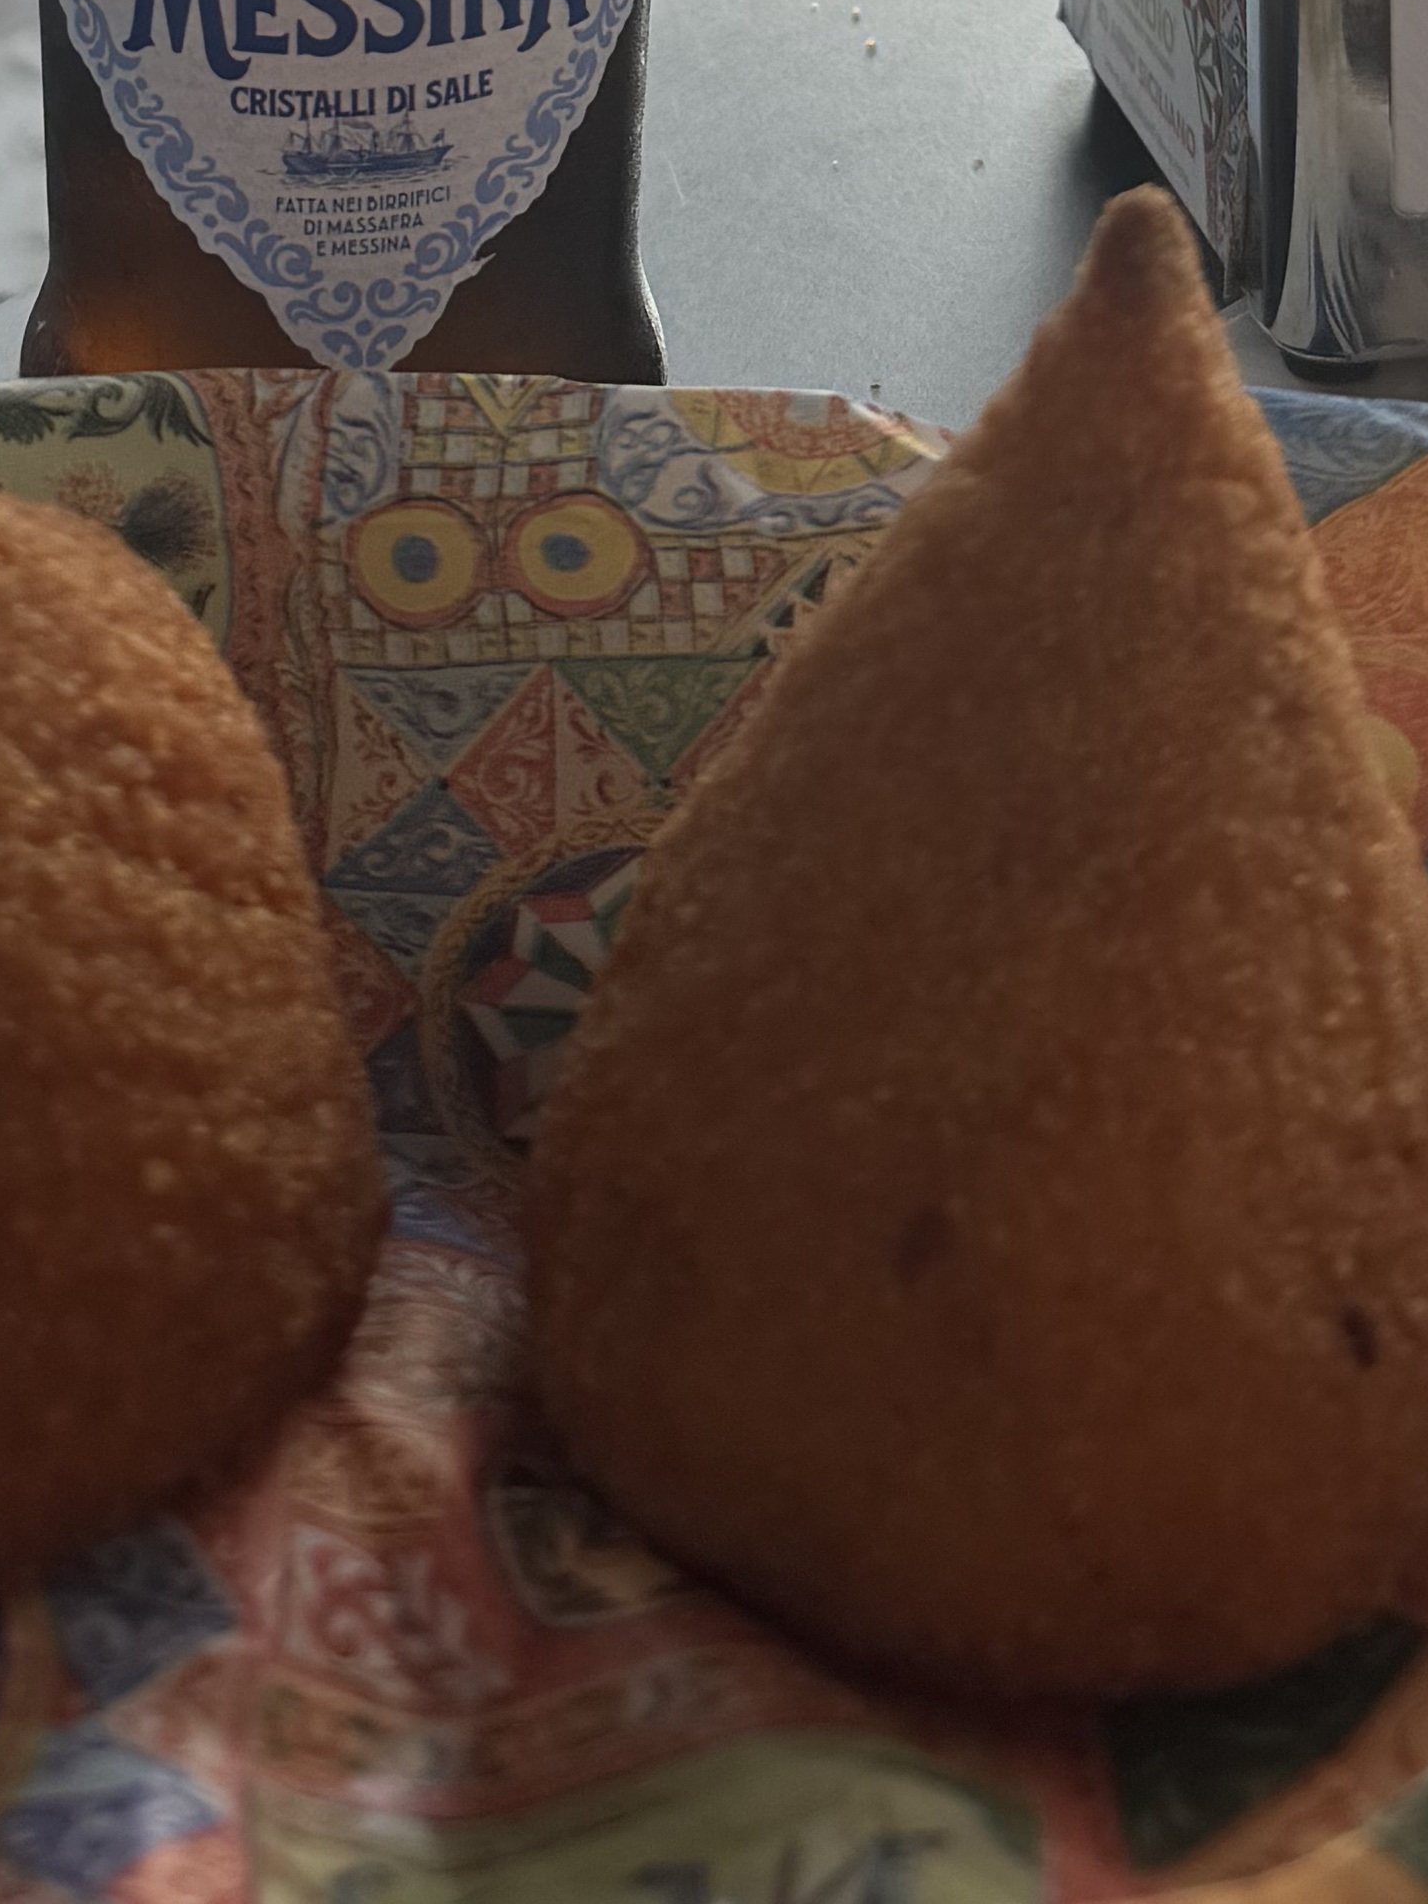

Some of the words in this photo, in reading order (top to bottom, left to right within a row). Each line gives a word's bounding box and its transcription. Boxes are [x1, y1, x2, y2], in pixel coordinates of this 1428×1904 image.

[230, 85, 375, 121] CRISTALLI
[386, 85, 415, 115] DI
[425, 68, 494, 110] SALE
[275, 196, 328, 213] FATTA
[332, 197, 362, 213] NEI
[366, 185, 451, 212] BIRRIFICI
[304, 219, 322, 235] DI
[326, 212, 424, 235] MASSAFRA
[316, 240, 326, 256] E
[331, 235, 411, 256] MESSINA
